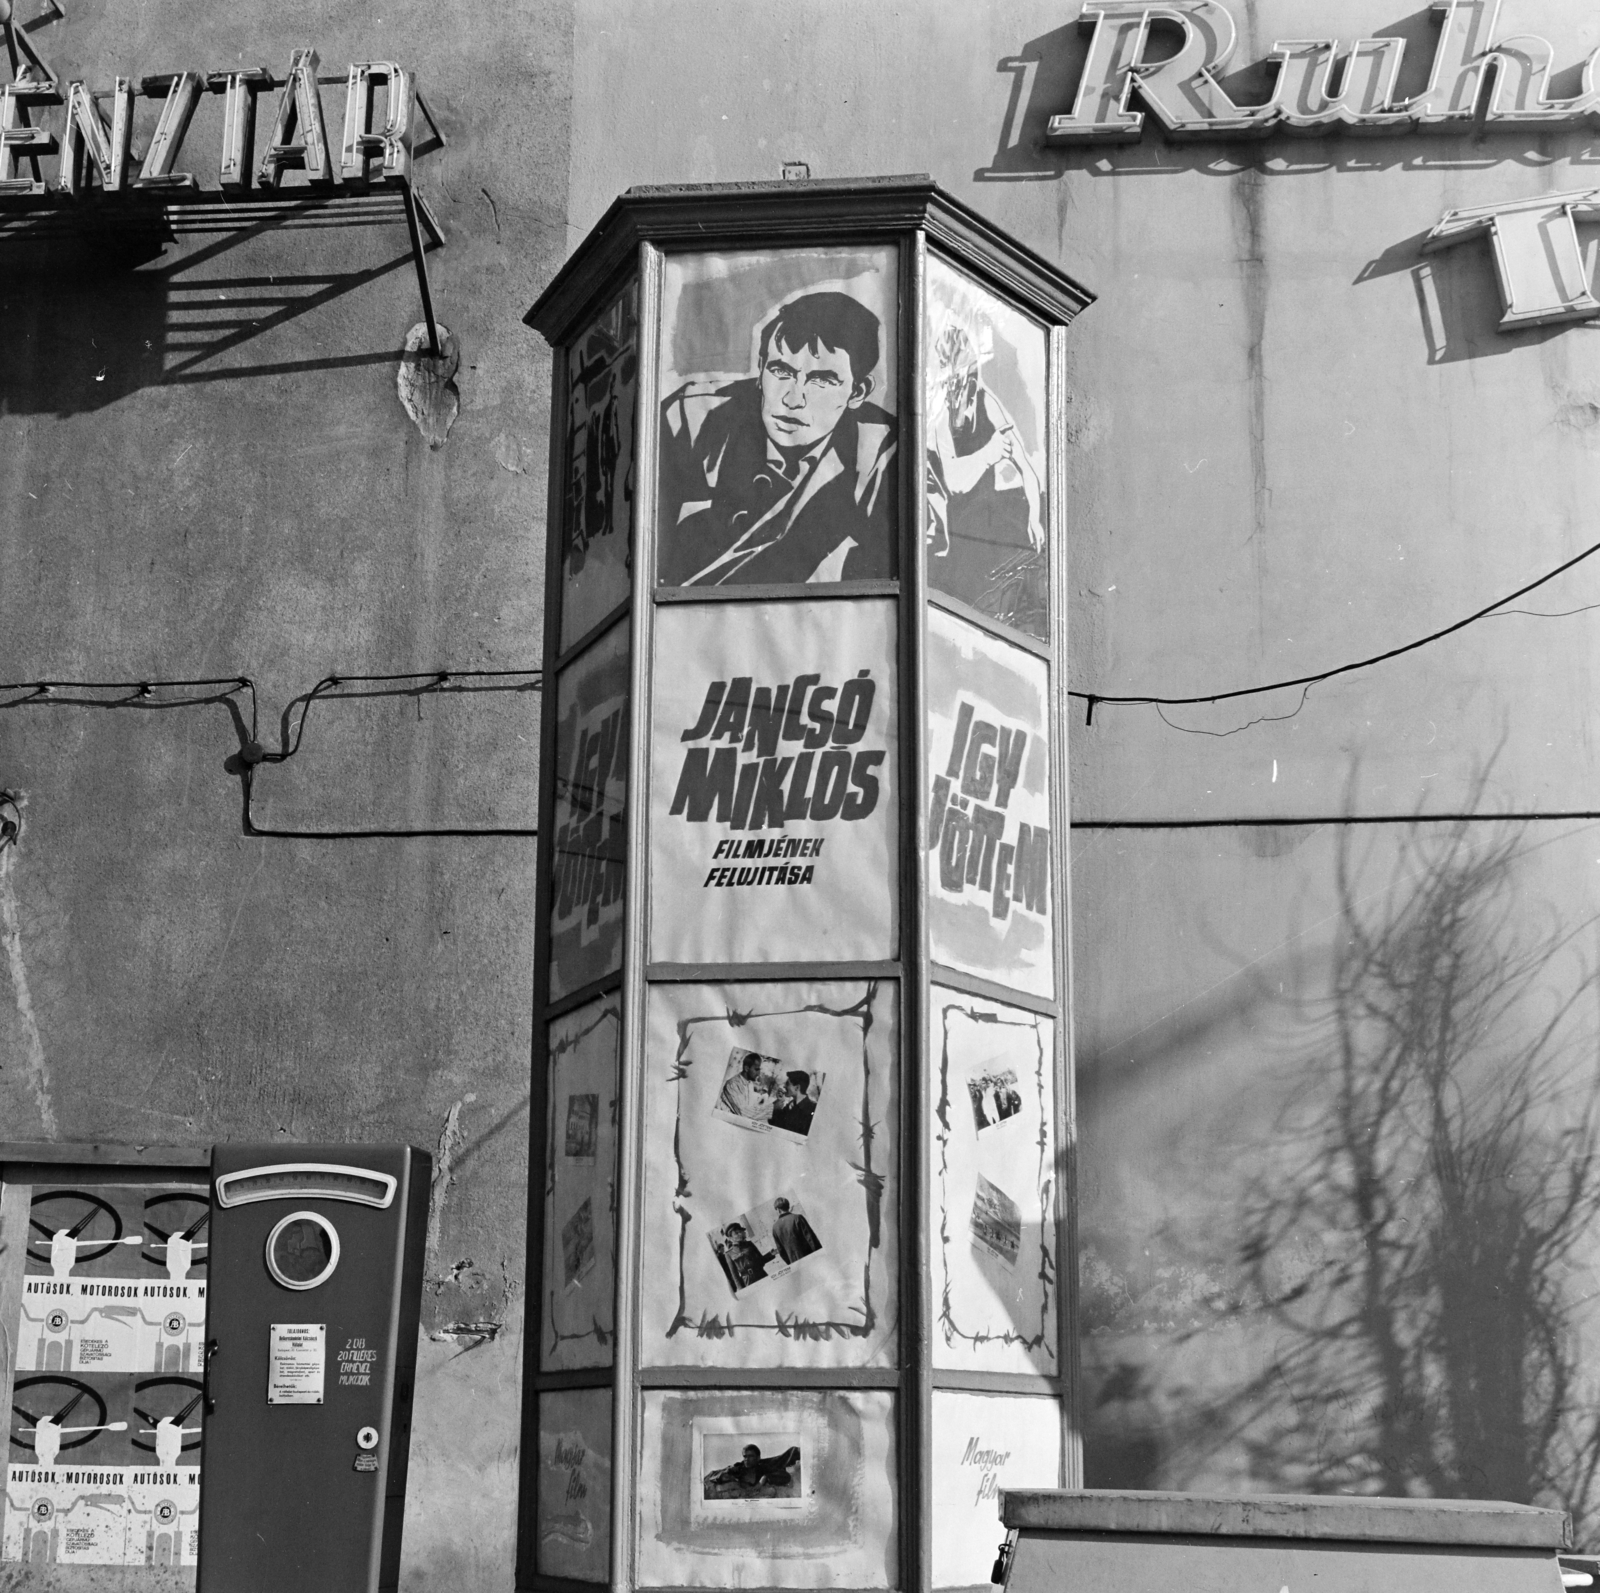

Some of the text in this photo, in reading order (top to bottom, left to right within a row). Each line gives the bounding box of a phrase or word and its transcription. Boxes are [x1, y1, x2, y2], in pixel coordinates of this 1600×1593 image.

[681, 669, 876, 758] JANCSÓ
[945, 701, 1027, 809] IGY
[669, 745, 886, 831] MIKLÓS
[712, 834, 825, 859] FILMJÉNEK
[929, 774, 1049, 921] JÖTTEM
[703, 861, 815, 888] FELUJITÁSA
[26, 1281, 139, 1298] AUTÓSOK, MOTOROSOK
[143, 1284, 191, 1299] AUTÓSOK,
[337, 1350, 349, 1361] 20
[345, 1338, 352, 1349] 2
[961, 1436, 1011, 1472] Magyar
[11, 1469, 125, 1485] AUTÓSOK, MOTOROSOK
[133, 1471, 182, 1486] AUTÓSOK,
